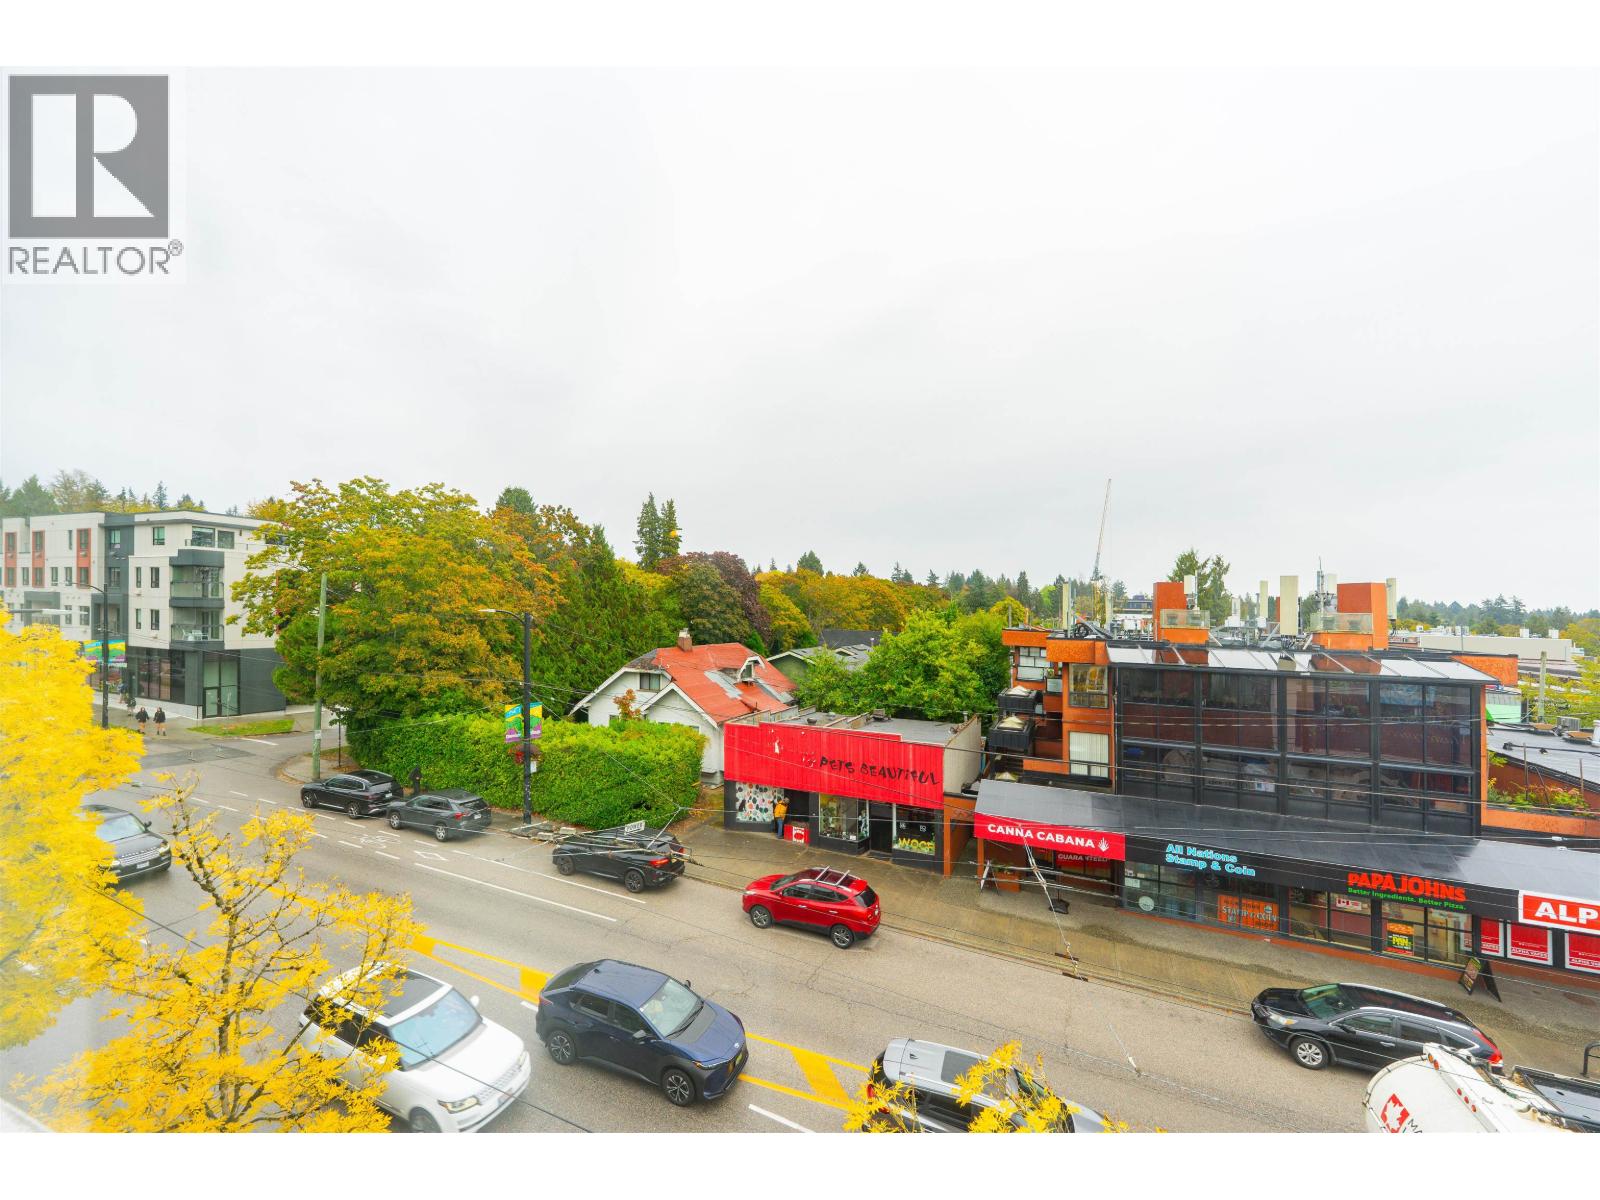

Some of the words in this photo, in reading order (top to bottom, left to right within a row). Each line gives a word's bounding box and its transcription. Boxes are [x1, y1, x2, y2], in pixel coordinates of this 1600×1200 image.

[819, 756, 855, 774] PETS
[860, 763, 941, 785] BEAUTIFUL
[987, 823, 1034, 839] CANNA
[1036, 831, 1095, 849] CABANA
[1165, 843, 1184, 855] All
[1186, 846, 1238, 863] Nations
[1165, 853, 1208, 870] Stamp
[1210, 860, 1222, 871] &
[1224, 863, 1256, 877] Coin
[1347, 871, 1397, 893] PAPA
[1398, 875, 1467, 902] JOHNS
[1347, 887, 1371, 896] Better
[1419, 897, 1443, 907] Better
